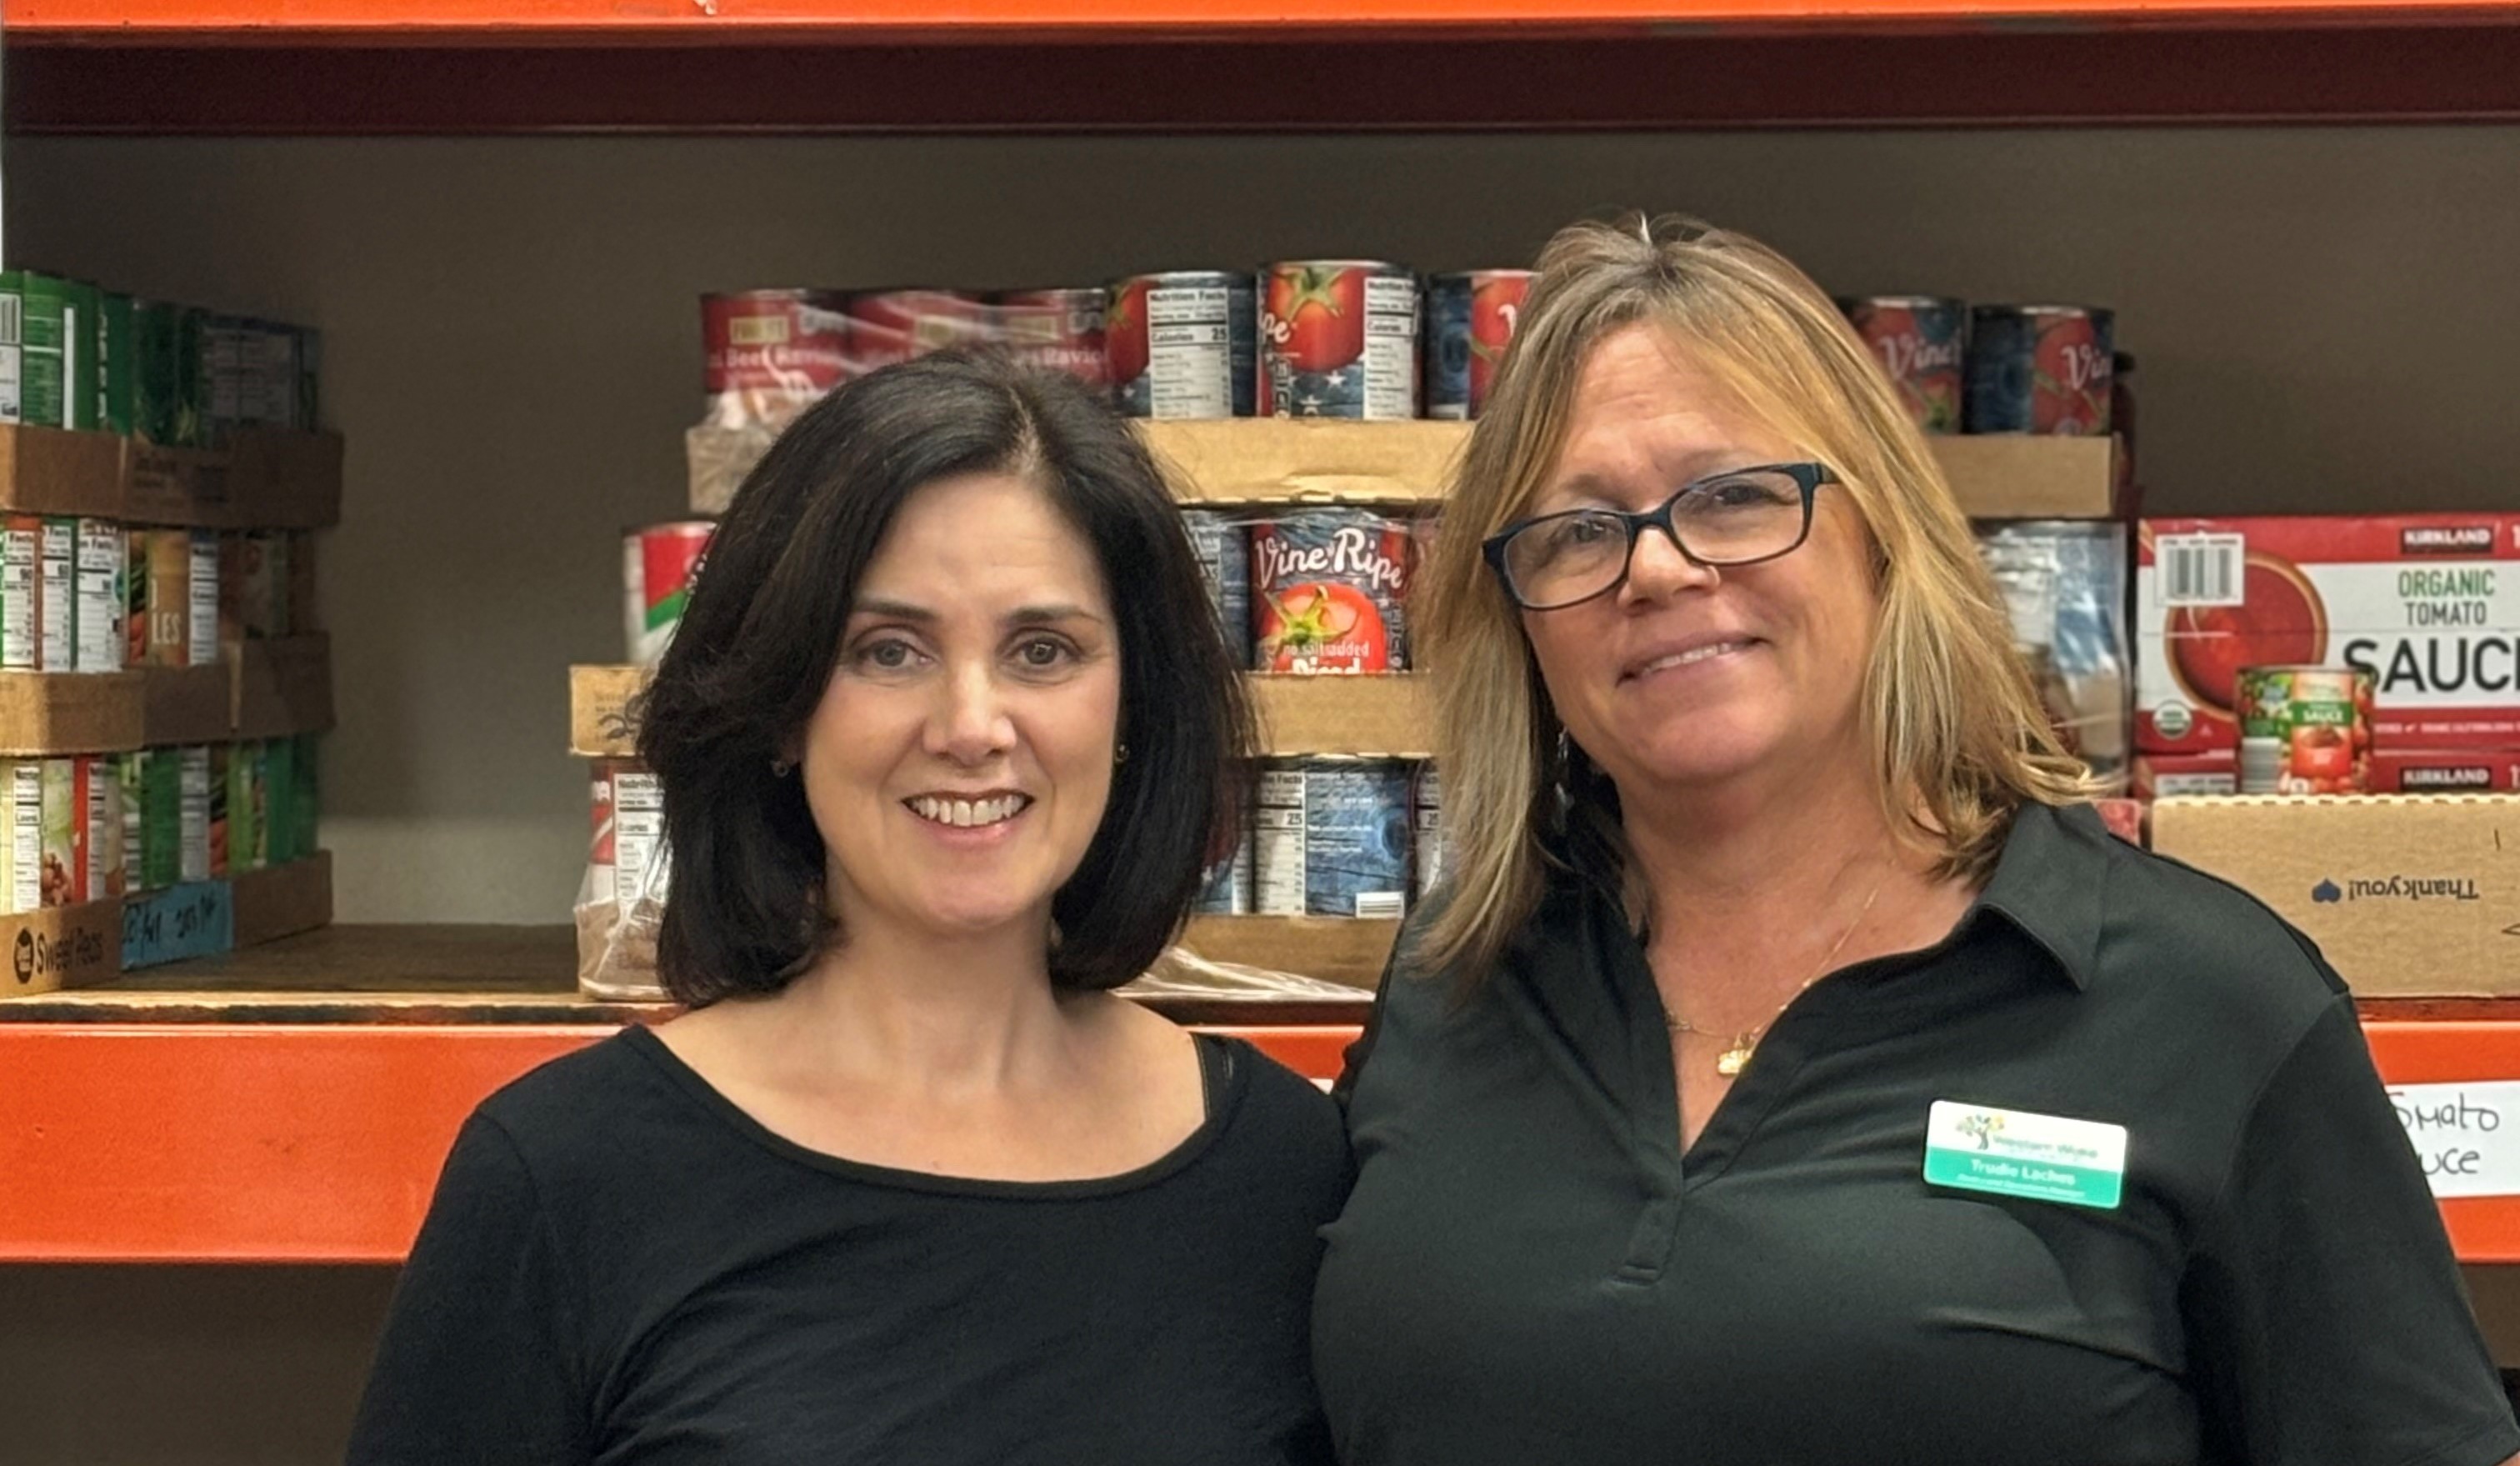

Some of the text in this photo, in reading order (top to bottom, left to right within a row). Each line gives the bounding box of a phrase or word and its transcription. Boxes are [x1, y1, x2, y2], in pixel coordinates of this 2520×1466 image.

[1150, 292, 1195, 301] Nutrition
[1212, 328, 1227, 340] 25
[2061, 343, 2112, 390] Vin
[2404, 528, 2491, 545] KIRKLAND
[1256, 528, 1402, 589] Vine Ripe
[2398, 569, 2496, 597] ORGANIC
[2405, 601, 2488, 625] TOMATO
[1325, 640, 1370, 657] added
[2343, 638, 2520, 693] SAUC
[2302, 710, 2343, 722] SAUCE
[2403, 768, 2490, 784] KIRKLAND
[1288, 813, 1302, 824] 25
[2348, 875, 2479, 901] Thankyou!
[37, 932, 73, 975] Sweet
[74, 927, 104, 968] Peas
[2388, 1092, 2499, 1132] omato
[2418, 1148, 2480, 1175] uce
